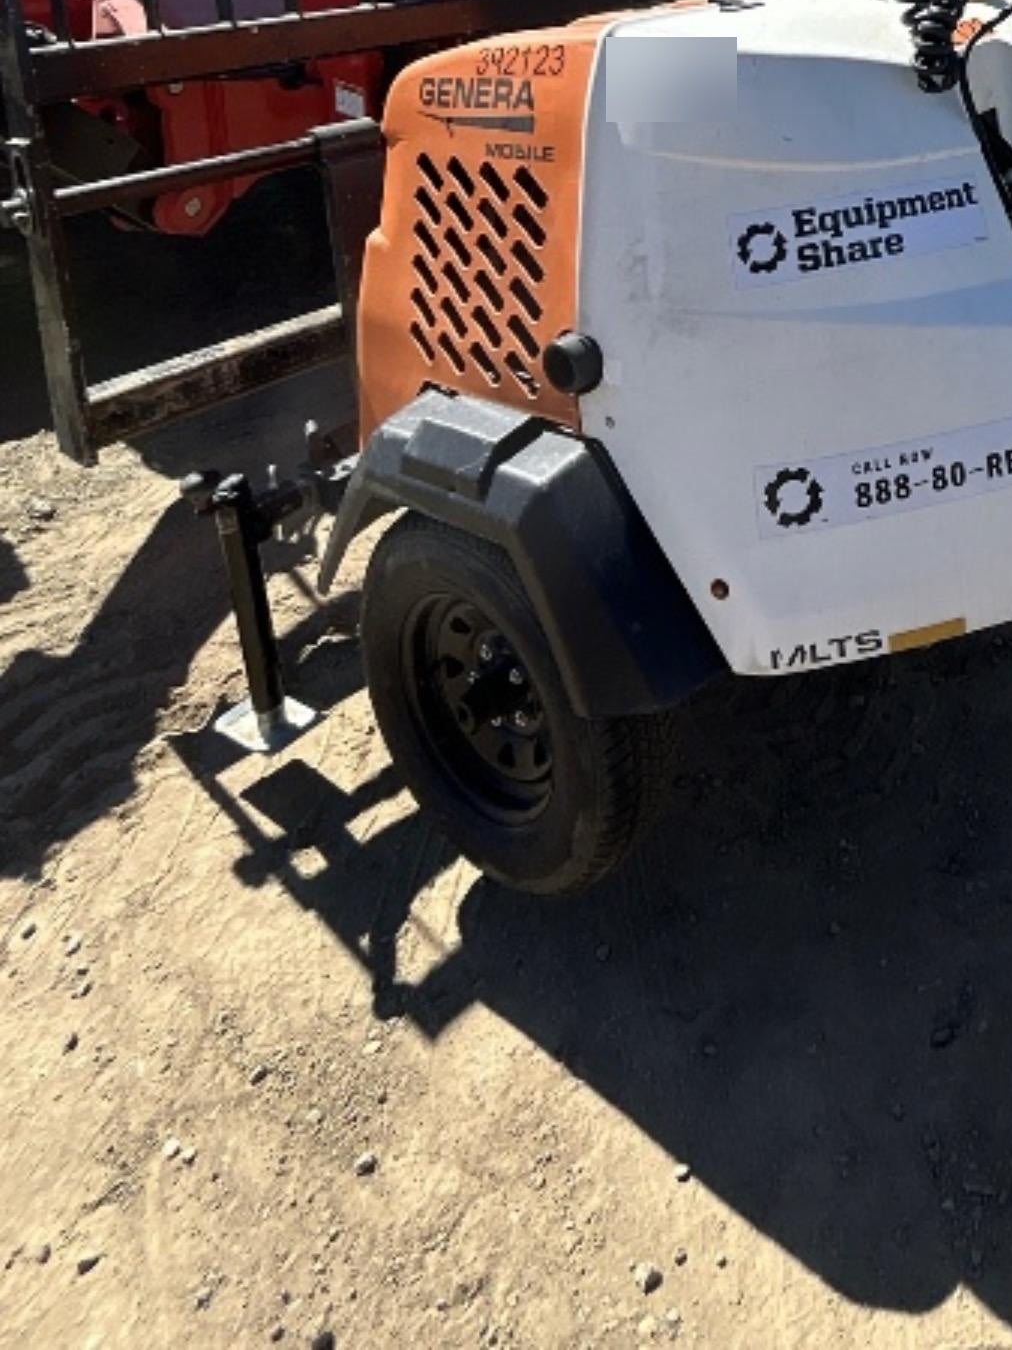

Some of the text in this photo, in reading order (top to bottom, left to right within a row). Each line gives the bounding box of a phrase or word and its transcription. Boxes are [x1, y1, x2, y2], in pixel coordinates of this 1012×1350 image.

[486, 143, 555, 162] MOBILE
[791, 181, 978, 239] Equipment
[797, 232, 905, 273] Share
[851, 458, 892, 475] CALL
